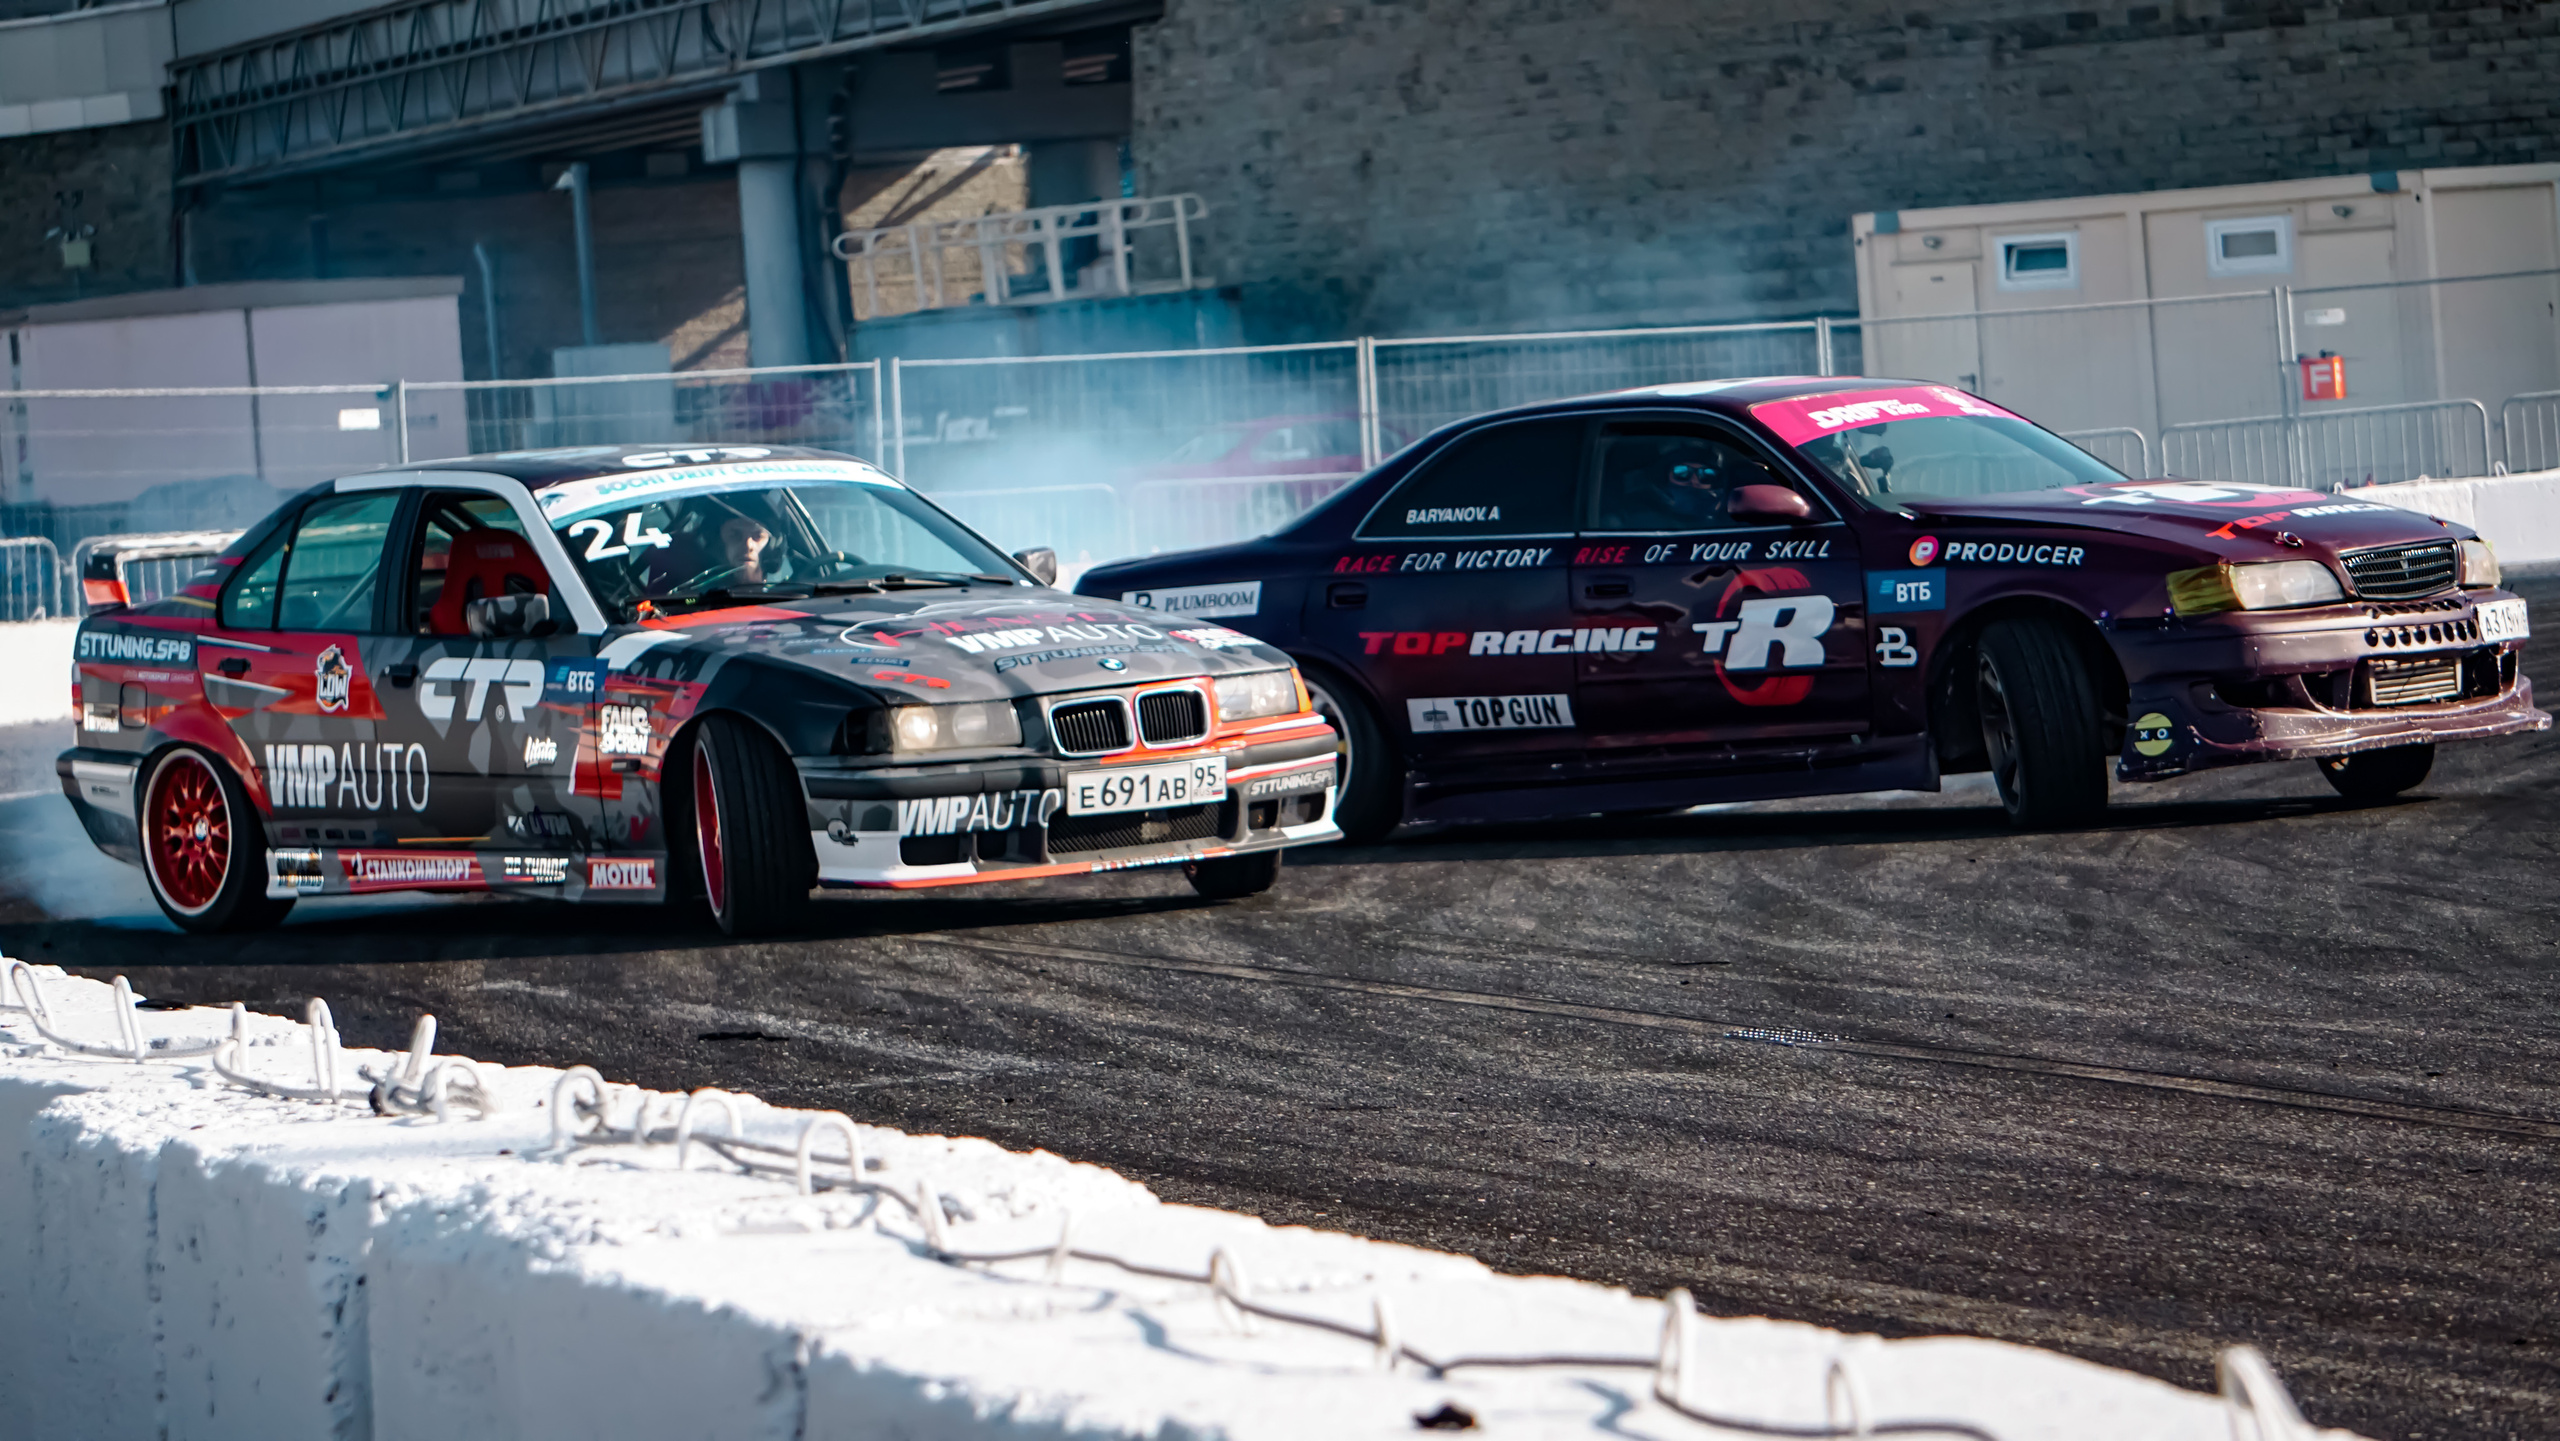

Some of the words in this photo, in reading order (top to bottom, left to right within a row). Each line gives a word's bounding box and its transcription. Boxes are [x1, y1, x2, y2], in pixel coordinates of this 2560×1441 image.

[2309, 363, 2331, 395] F
[596, 474, 666, 495] SOCHI
[668, 466, 726, 482] DRIFT
[1487, 506, 1501, 521] A
[568, 512, 673, 563] 24
[1334, 555, 1397, 573] RACE
[1400, 552, 1448, 572] FOR
[1454, 548, 1553, 570] VICTORY
[1574, 546, 1631, 564] RISE
[1644, 543, 1678, 563] OF
[1690, 542, 1752, 561] YOUR
[1765, 540, 1831, 559] SKILL
[1944, 541, 2086, 565] PRODUCER
[1164, 590, 1256, 613] PLUMBOOM
[1896, 581, 1932, 602] ВТБ
[79, 631, 191, 662] STTUNING.SPB
[945, 623, 1164, 654] VMPAUTO
[265, 742, 430, 813] VMPAUTO
[1194, 765, 1217, 788] 95
[898, 788, 1062, 838] VMPAUTO
[365, 859, 471, 881] СТАНКОИМПОРТ
[592, 863, 653, 887] MOTUL
